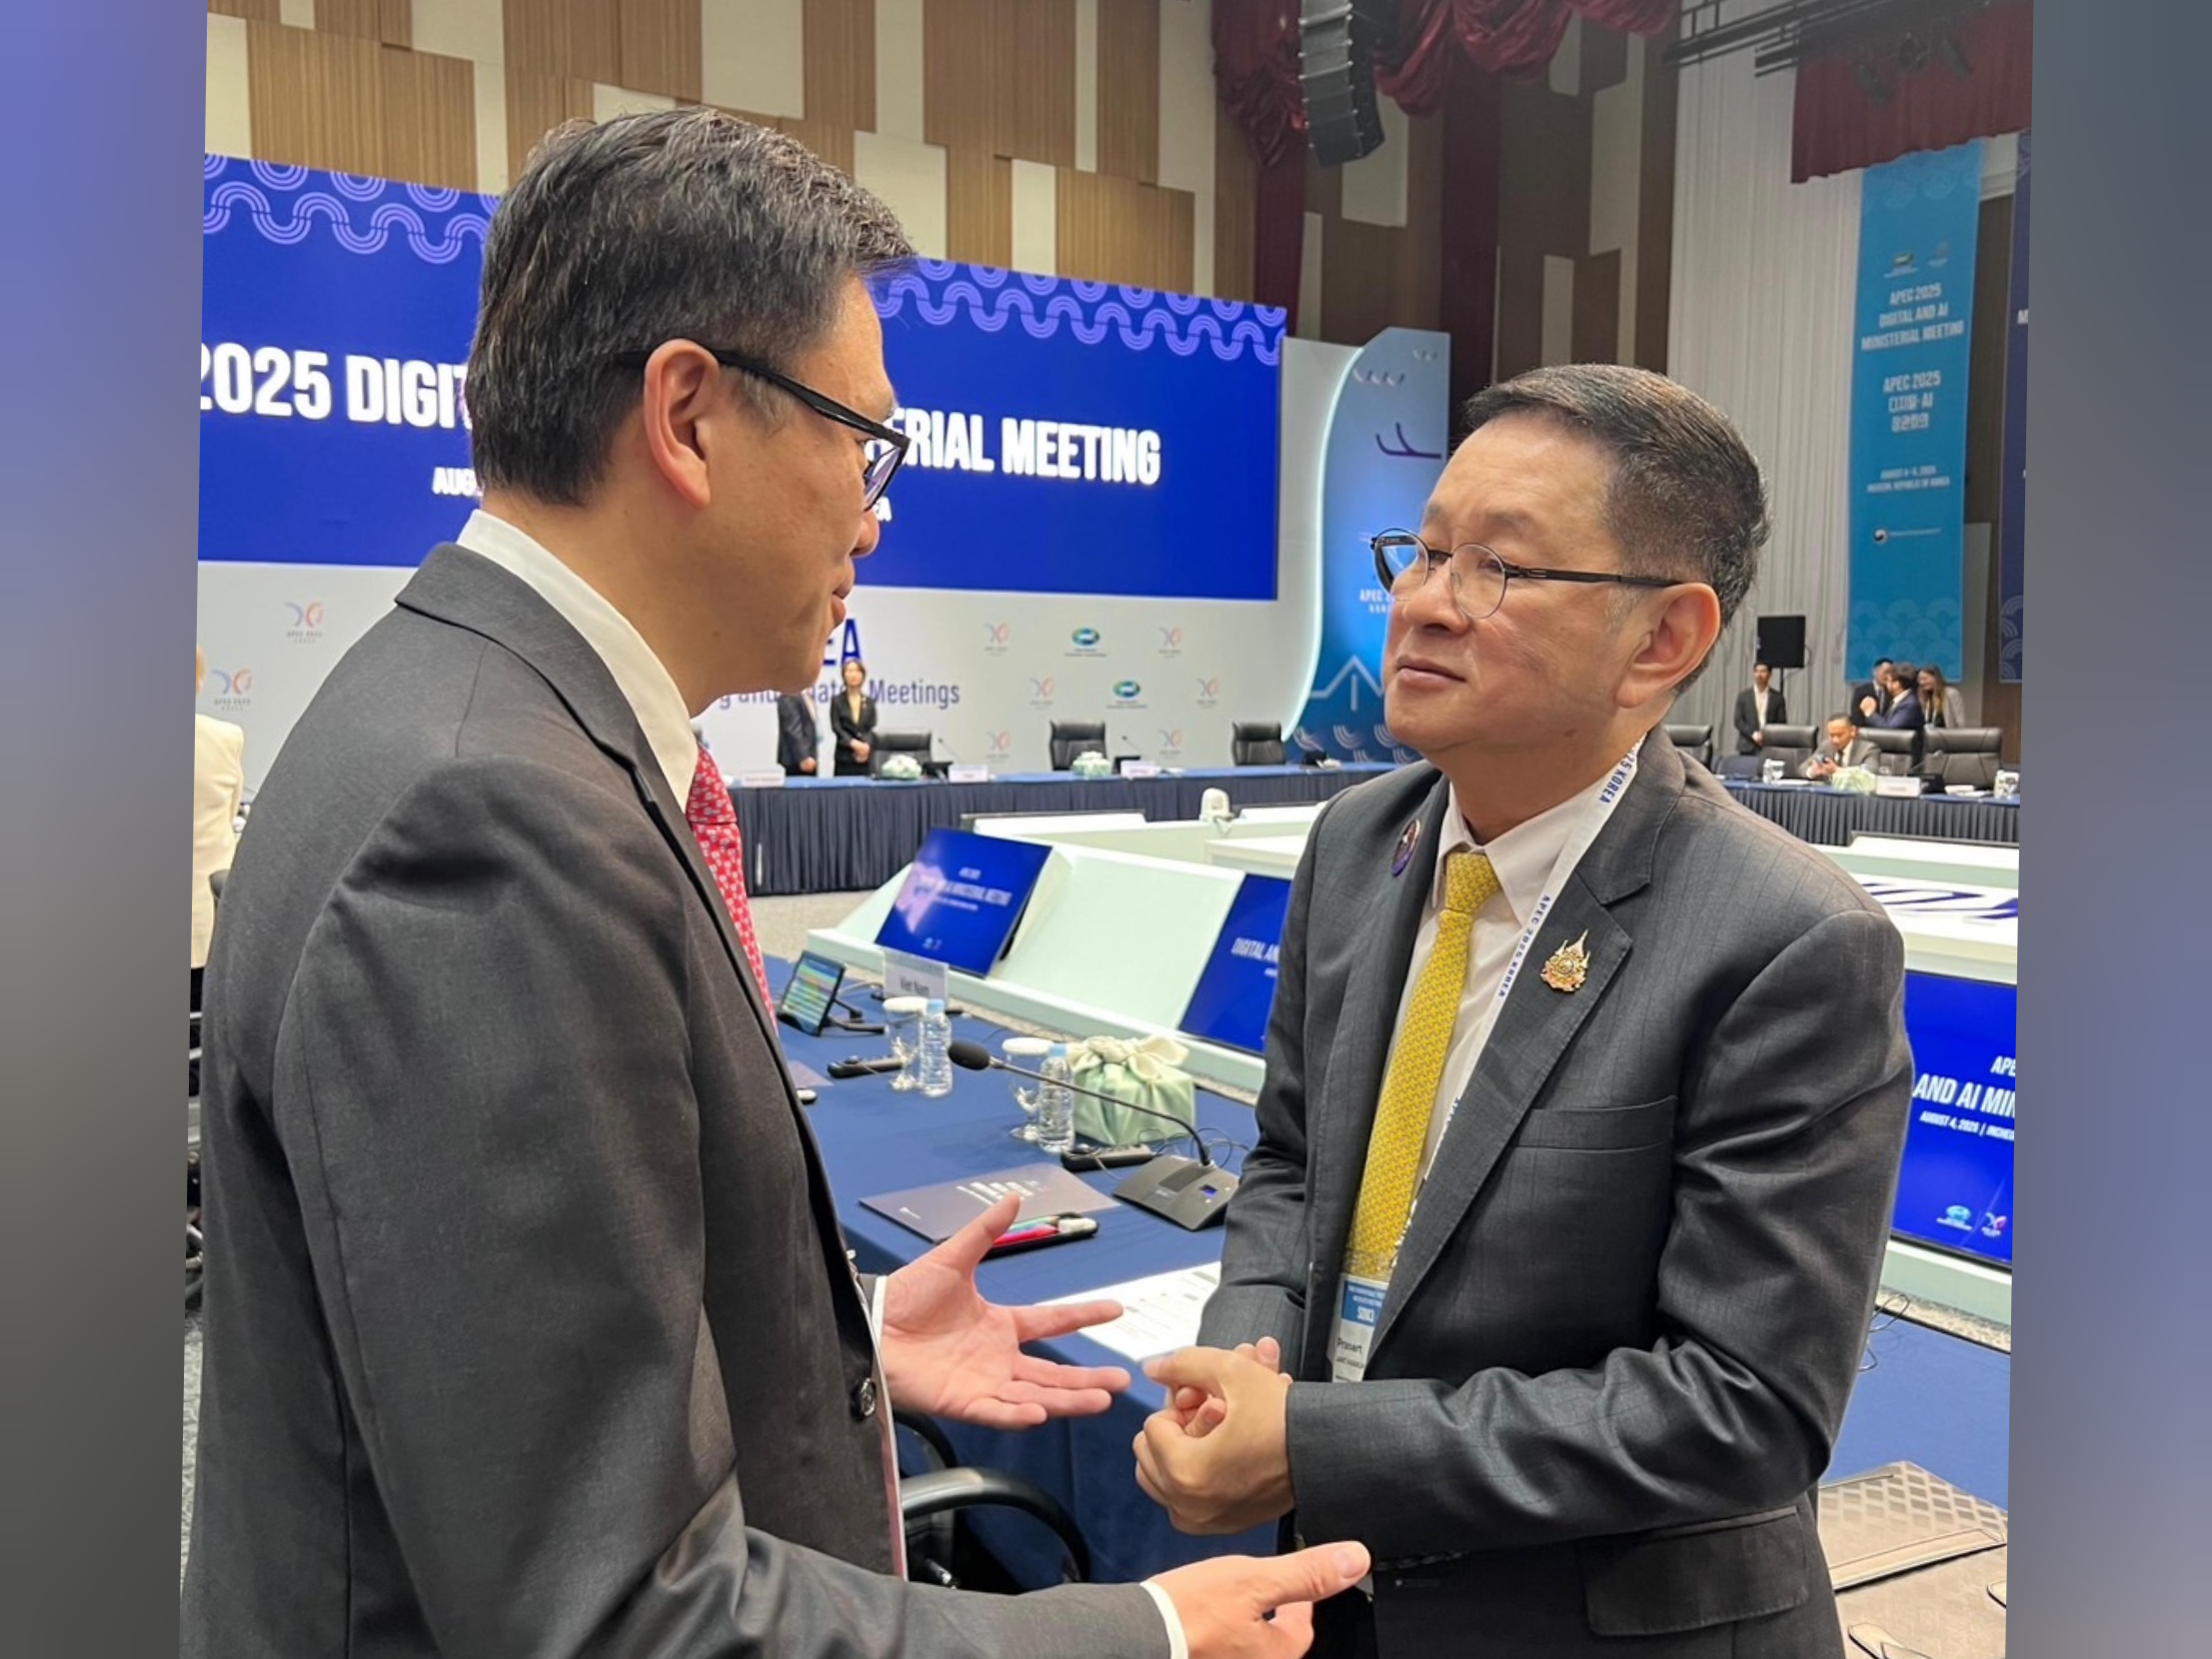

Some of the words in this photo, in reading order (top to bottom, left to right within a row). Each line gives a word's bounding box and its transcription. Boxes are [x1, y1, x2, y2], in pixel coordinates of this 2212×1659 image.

[1883, 373, 1910, 393] APEC
[1912, 370, 1941, 389] 2025
[1002, 417, 1160, 486] MEETING
[432, 467, 483, 497] AUG
[869, 679, 961, 710] Meetings
[1599, 769, 1627, 804] KOREA
[1530, 894, 1551, 925] APEC
[1498, 961, 1518, 997] KOREA
[1912, 1072, 1958, 1105] AND
[1955, 1081, 1983, 1111] AI
